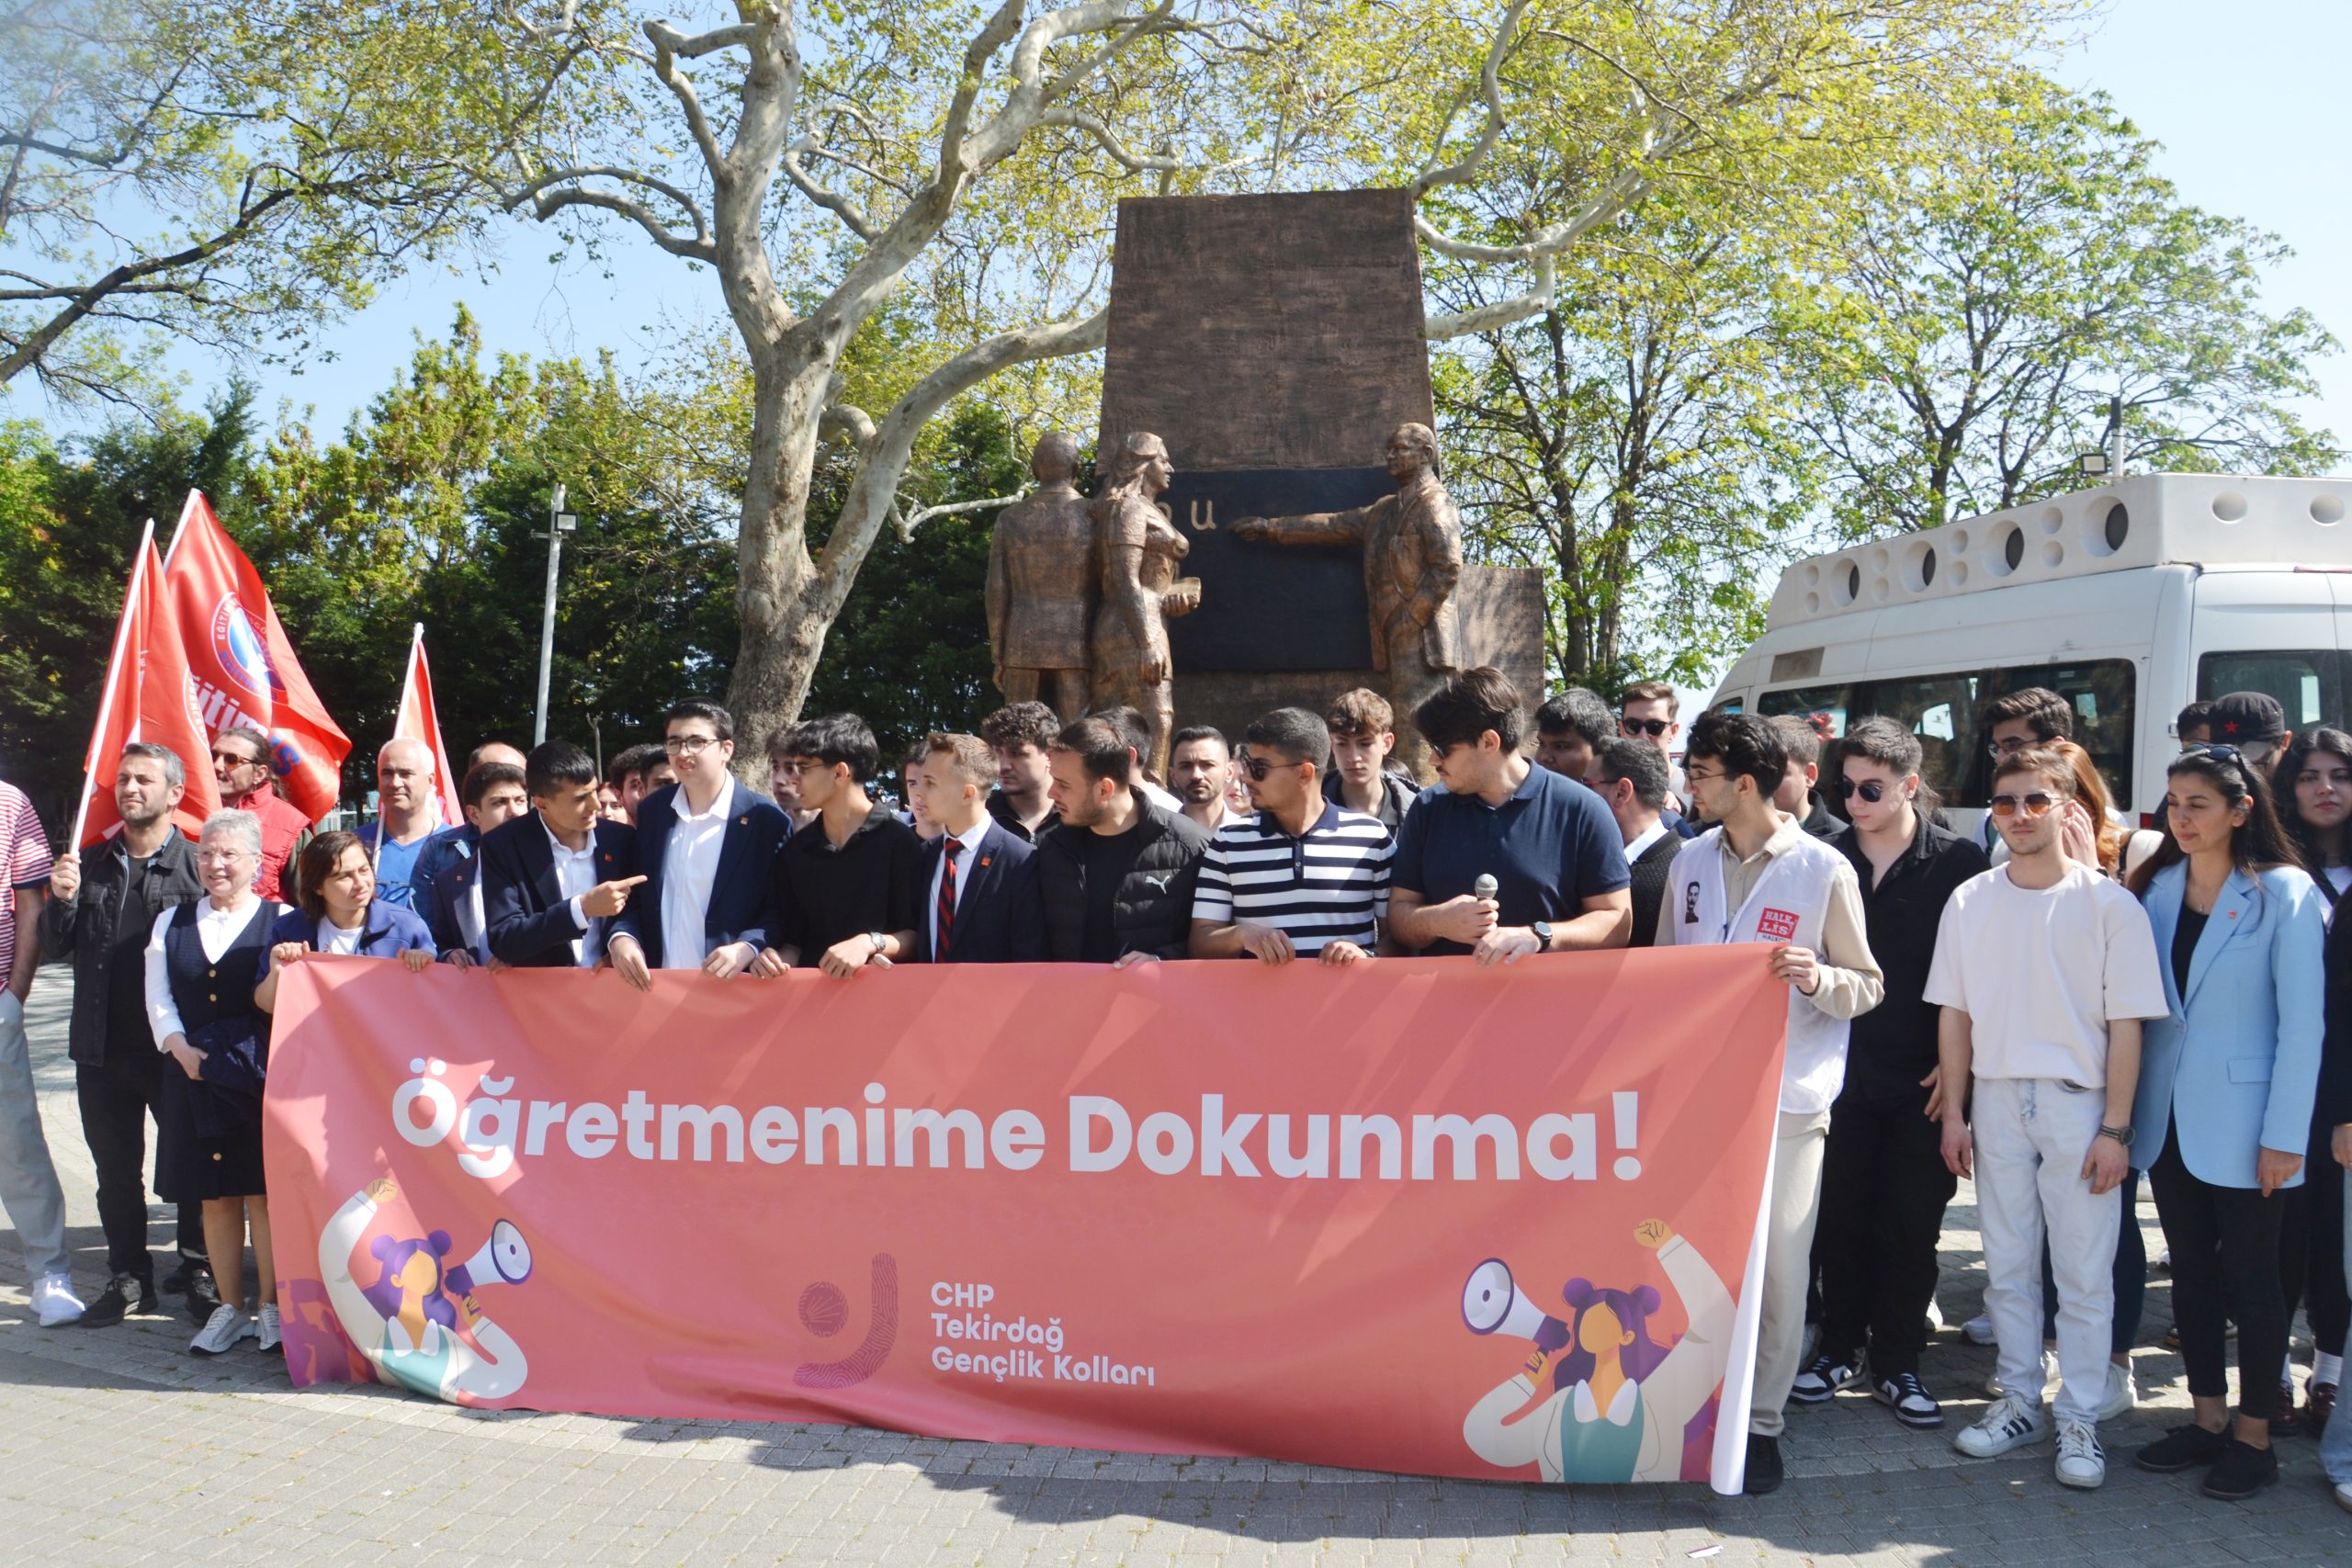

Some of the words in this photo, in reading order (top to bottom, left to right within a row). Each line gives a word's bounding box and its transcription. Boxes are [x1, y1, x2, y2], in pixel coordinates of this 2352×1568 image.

[1191, 500, 1217, 530] u
[392, 1057, 1046, 1179] Öğretmenime
[1069, 1091, 1642, 1181] Dokunma!
[931, 1281, 994, 1309] CHP
[931, 1313, 1064, 1353] Tekirdağ
[932, 1347, 1044, 1382] Gençlik
[1054, 1354, 1155, 1386] Kolları
